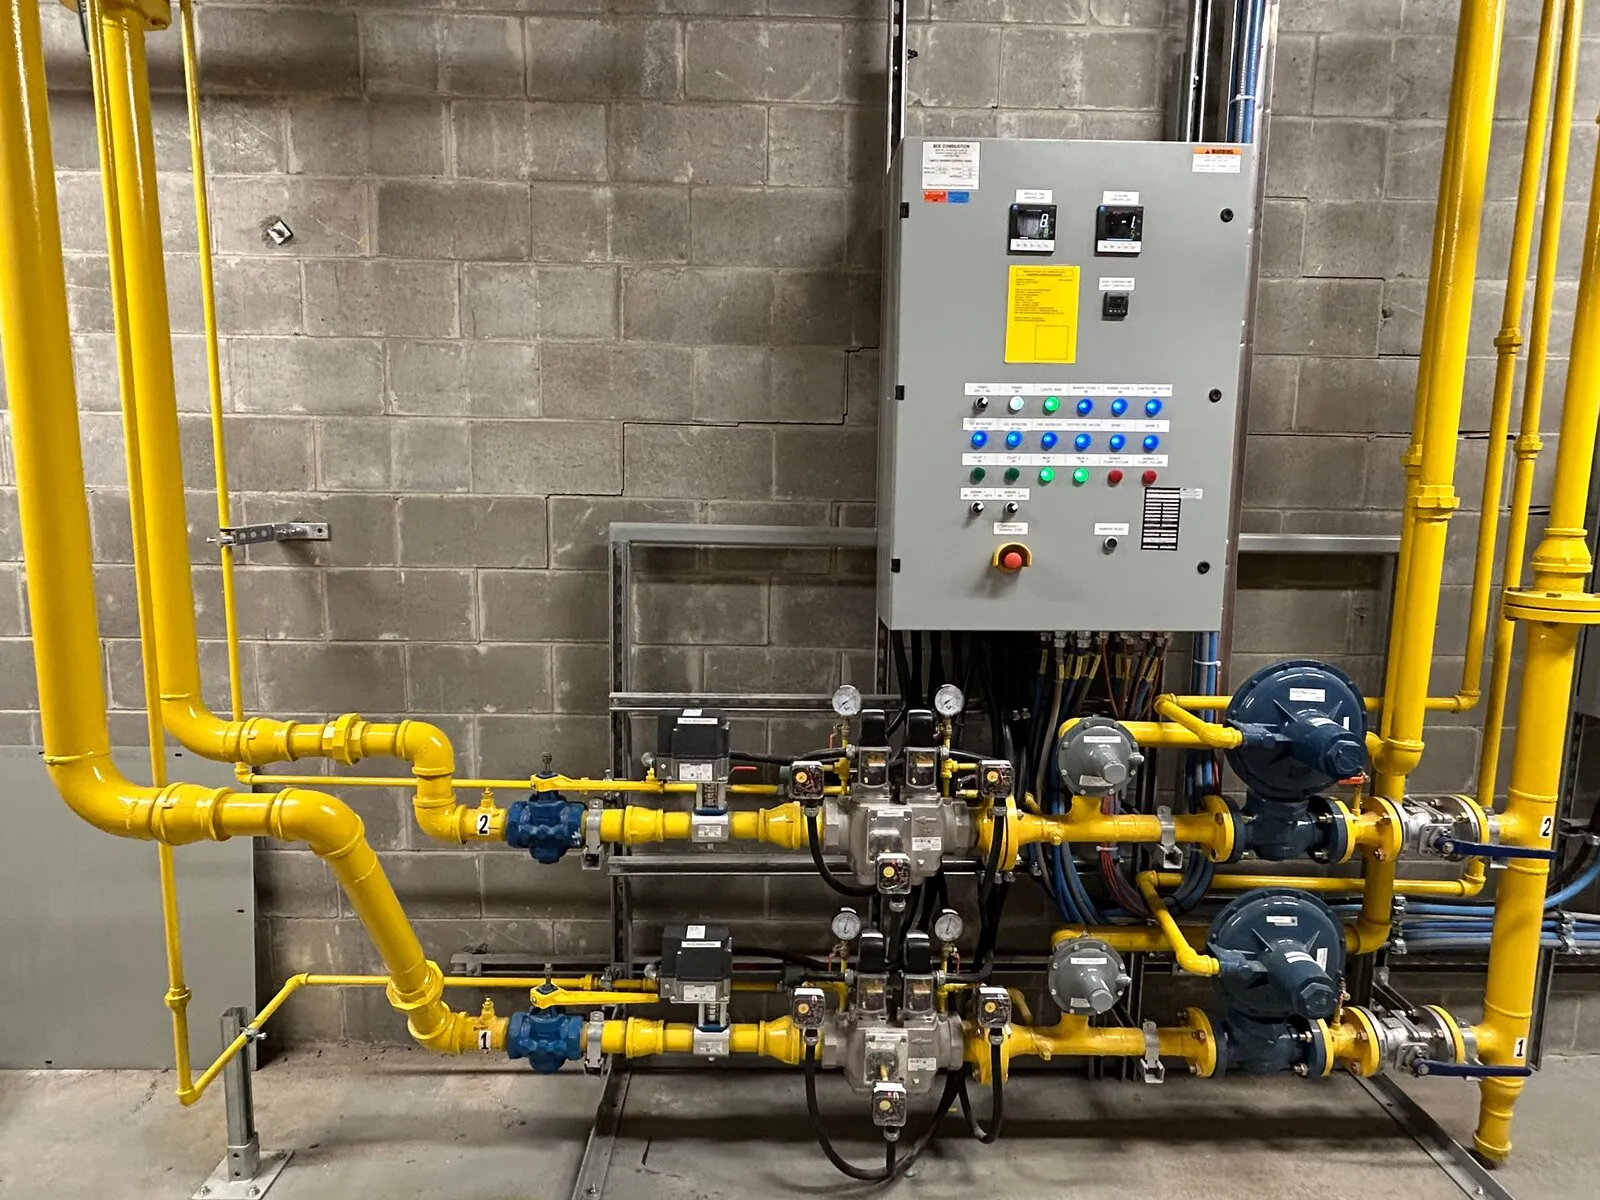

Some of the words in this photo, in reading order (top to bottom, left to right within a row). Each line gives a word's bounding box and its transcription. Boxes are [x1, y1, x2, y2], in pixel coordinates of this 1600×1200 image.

[1040, 213, 1049, 228] 8
[479, 815, 488, 835] 2
[1541, 817, 1552, 837] 2
[480, 1031, 489, 1050] 1
[1516, 1039, 1524, 1057] 1
